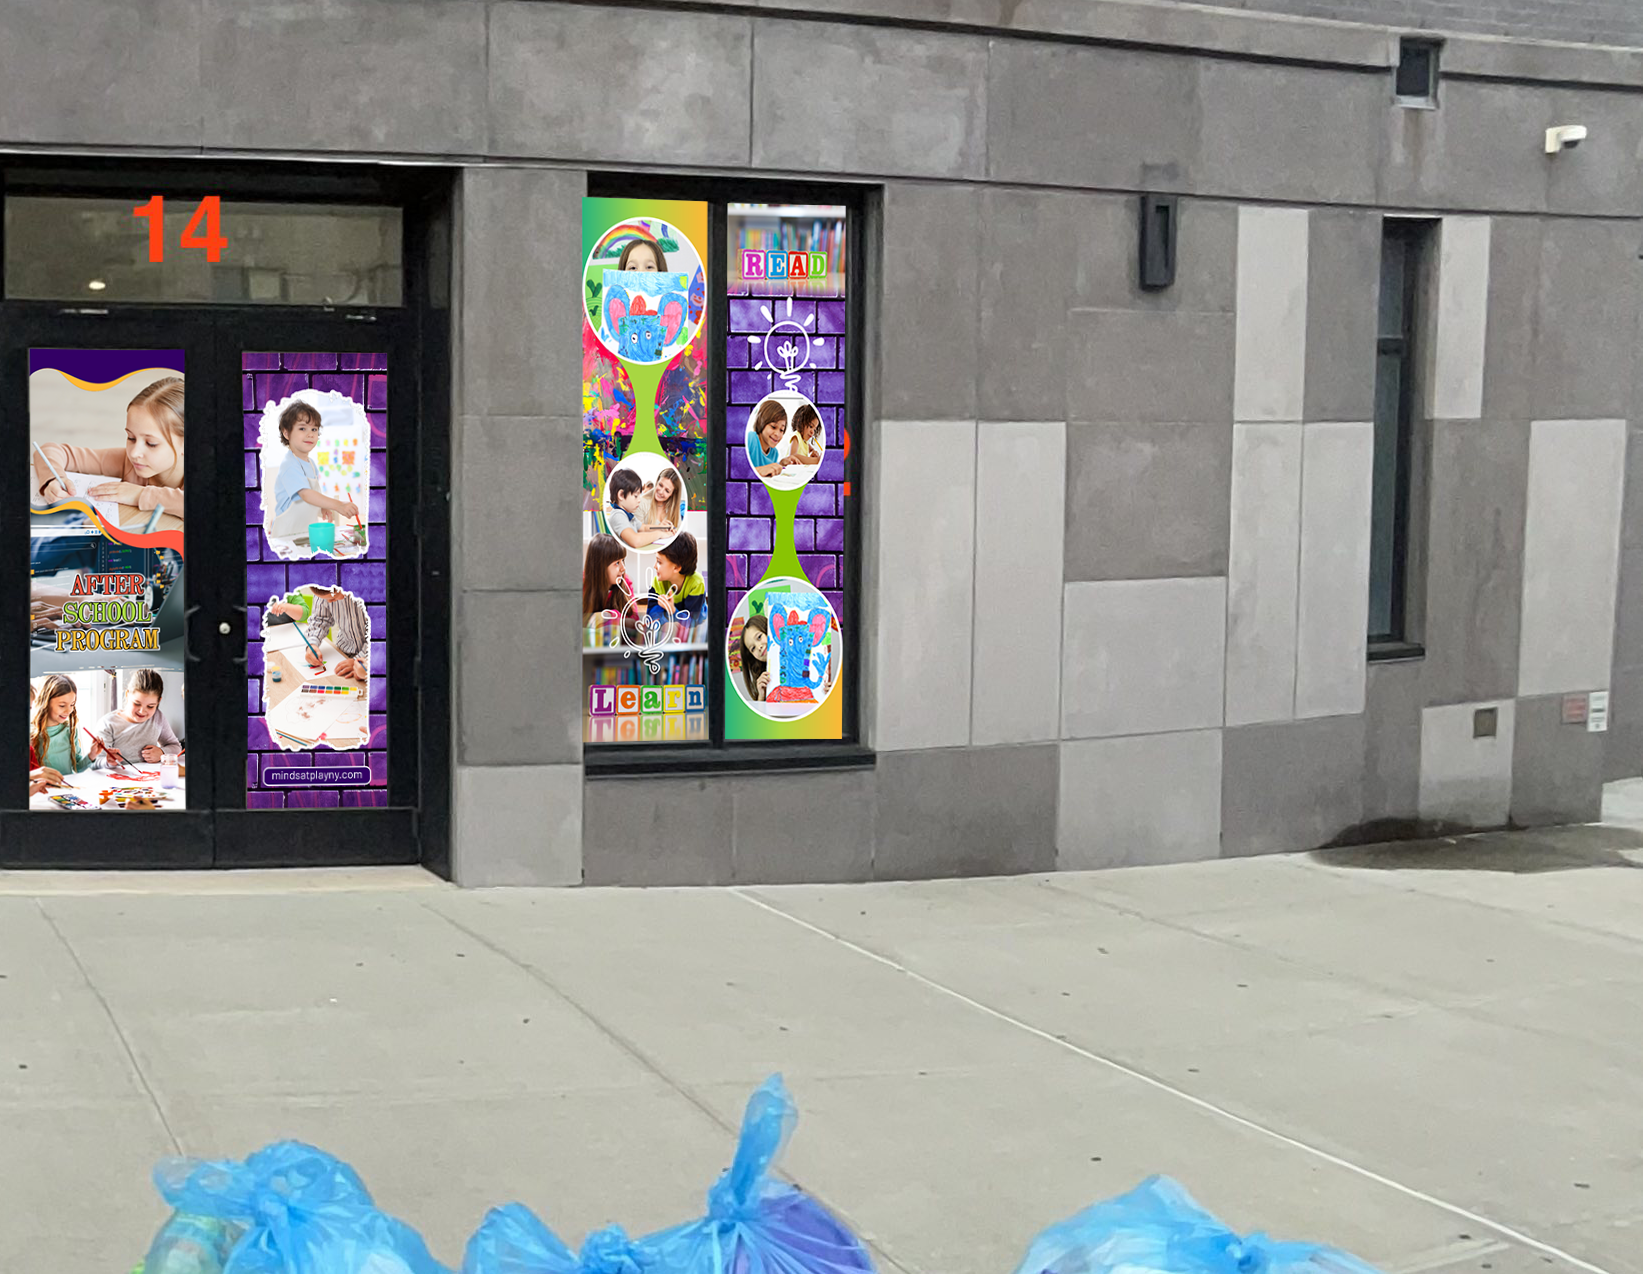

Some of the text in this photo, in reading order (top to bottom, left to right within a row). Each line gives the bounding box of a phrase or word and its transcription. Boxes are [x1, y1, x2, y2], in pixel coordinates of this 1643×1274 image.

[745, 253, 825, 277] READ
[70, 574, 145, 596] AFTER
[63, 601, 152, 624] SCHOOL
[55, 628, 160, 651] PROGRAM
[594, 689, 702, 713] Learn
[271, 770, 363, 782] mindsatplayny.com
